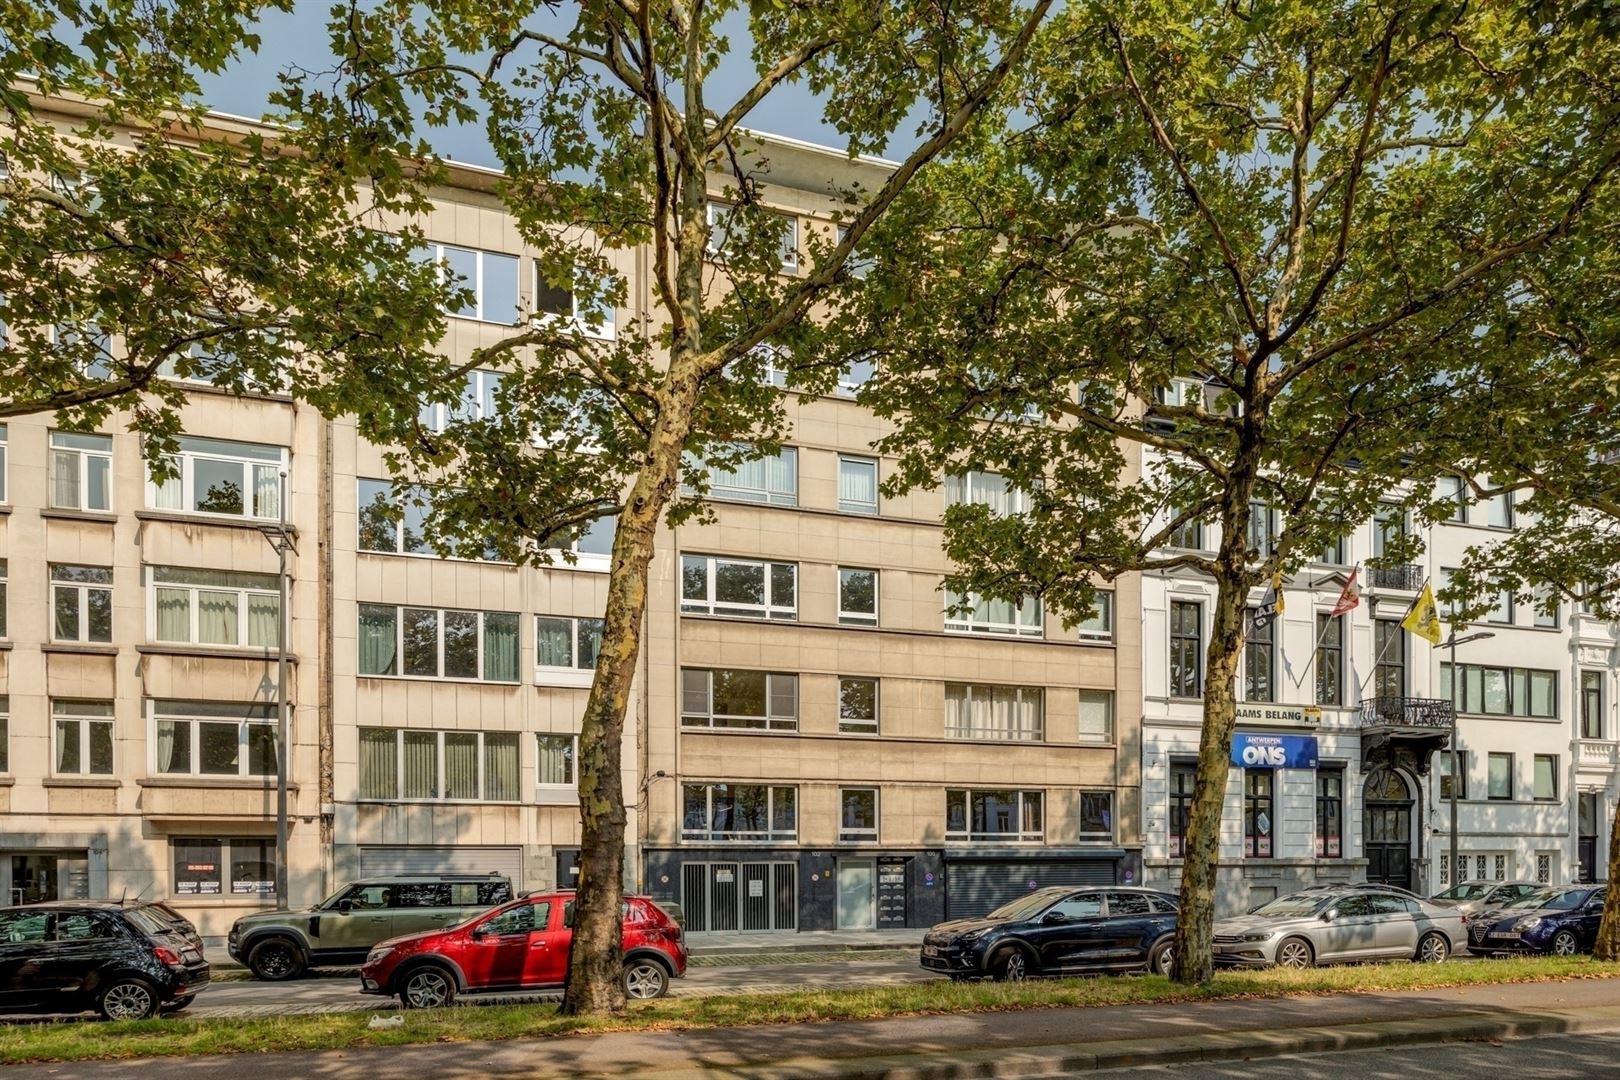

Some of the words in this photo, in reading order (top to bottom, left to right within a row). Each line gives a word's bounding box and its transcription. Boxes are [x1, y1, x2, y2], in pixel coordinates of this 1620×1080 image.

[1236, 709, 1261, 718] AAMS
[1265, 710, 1302, 720] BELANG
[1247, 736, 1281, 744] ANTWERPEN
[1243, 746, 1286, 765] ONS
